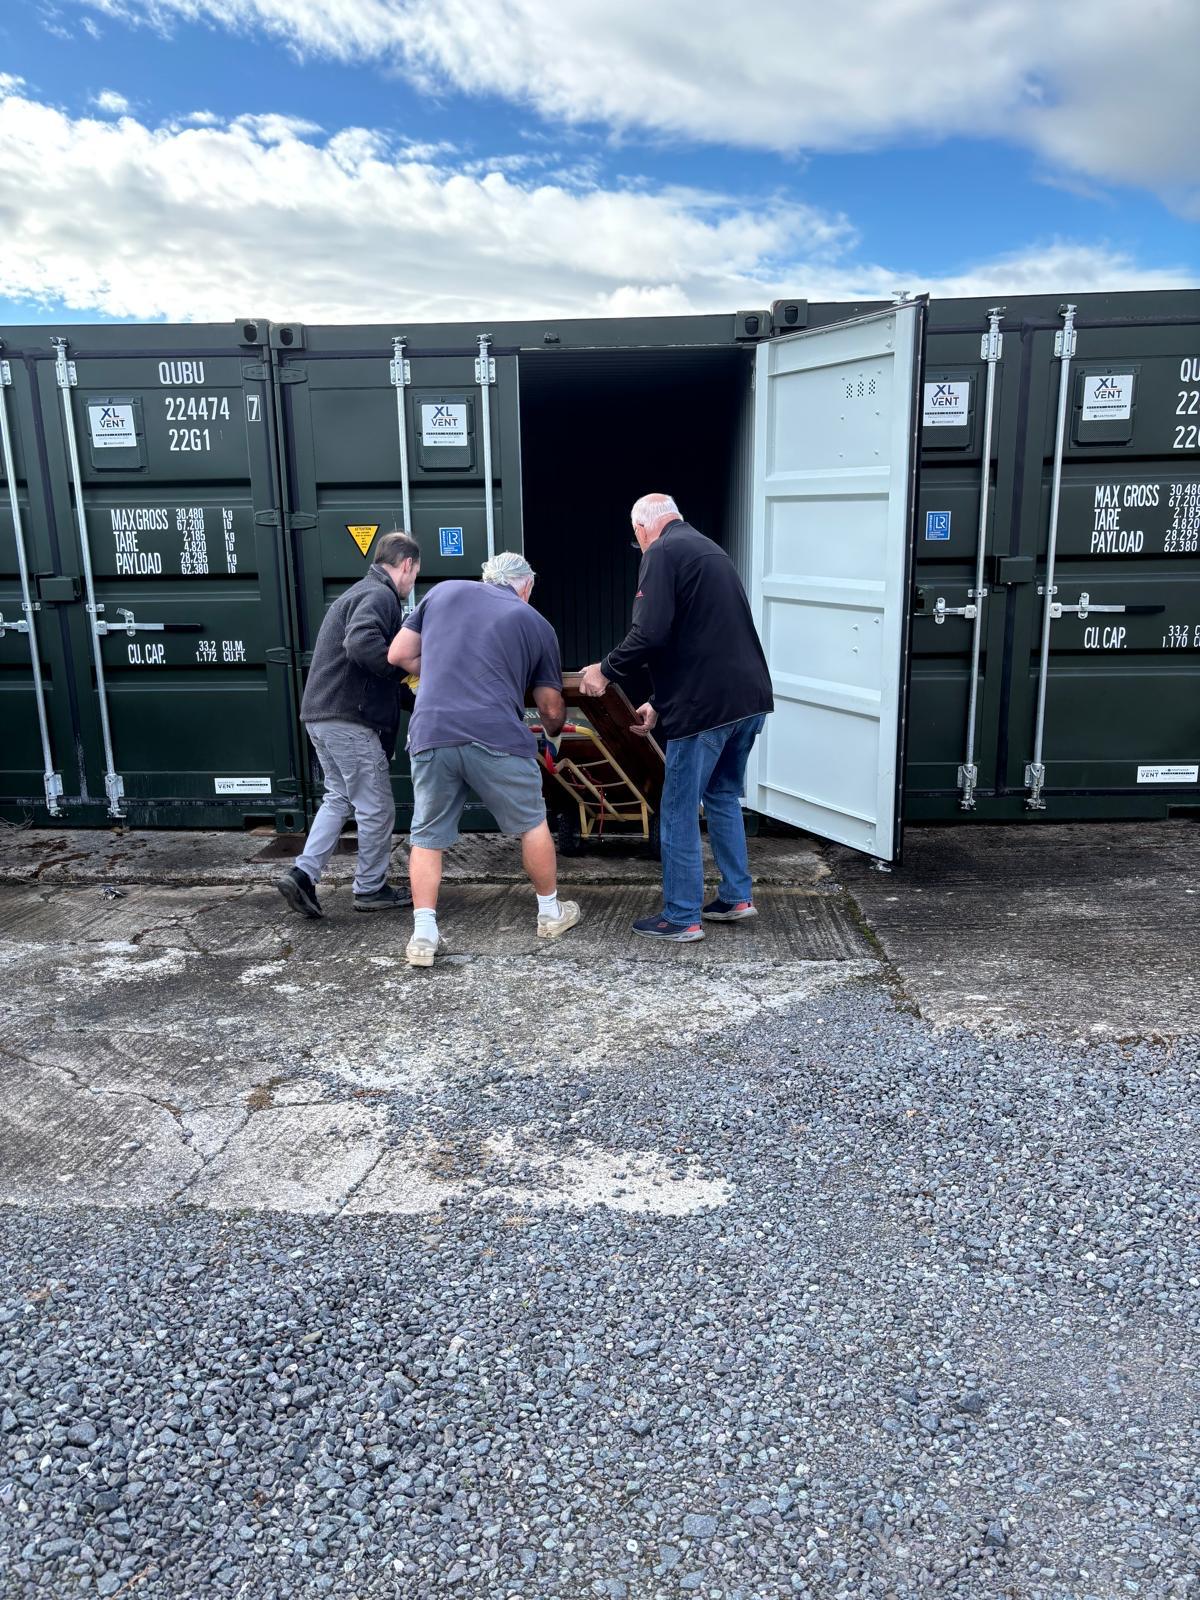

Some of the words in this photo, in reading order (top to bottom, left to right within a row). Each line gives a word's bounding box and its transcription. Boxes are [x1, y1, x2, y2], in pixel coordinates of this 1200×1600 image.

[158, 361, 204, 384] QUBU
[934, 384, 954, 398] XL
[1096, 378, 1118, 391] XL
[1094, 390, 1122, 399] VENT
[932, 397, 960, 406] VENT
[1176, 390, 1200, 414] 22
[100, 408, 120, 420] XL
[165, 397, 230, 420] 224474
[248, 397, 258, 420] 7
[432, 406, 452, 418] XL
[168, 429, 210, 450] 22G1
[1094, 485, 1120, 508] MAX
[1124, 484, 1160, 507] GROSS
[222, 508, 233, 520] kg
[1094, 508, 1121, 530] TARE
[224, 518, 232, 530] lb
[113, 531, 139, 552] TARE
[224, 530, 235, 542] kg
[225, 541, 234, 551] lb
[1090, 531, 1144, 553] PAYLOAD
[116, 552, 162, 574] PAYLOAD
[227, 552, 237, 565] kg
[228, 563, 236, 574] lb
[1168, 625, 1189, 636] 33.2
[199, 640, 216, 651] 33.2
